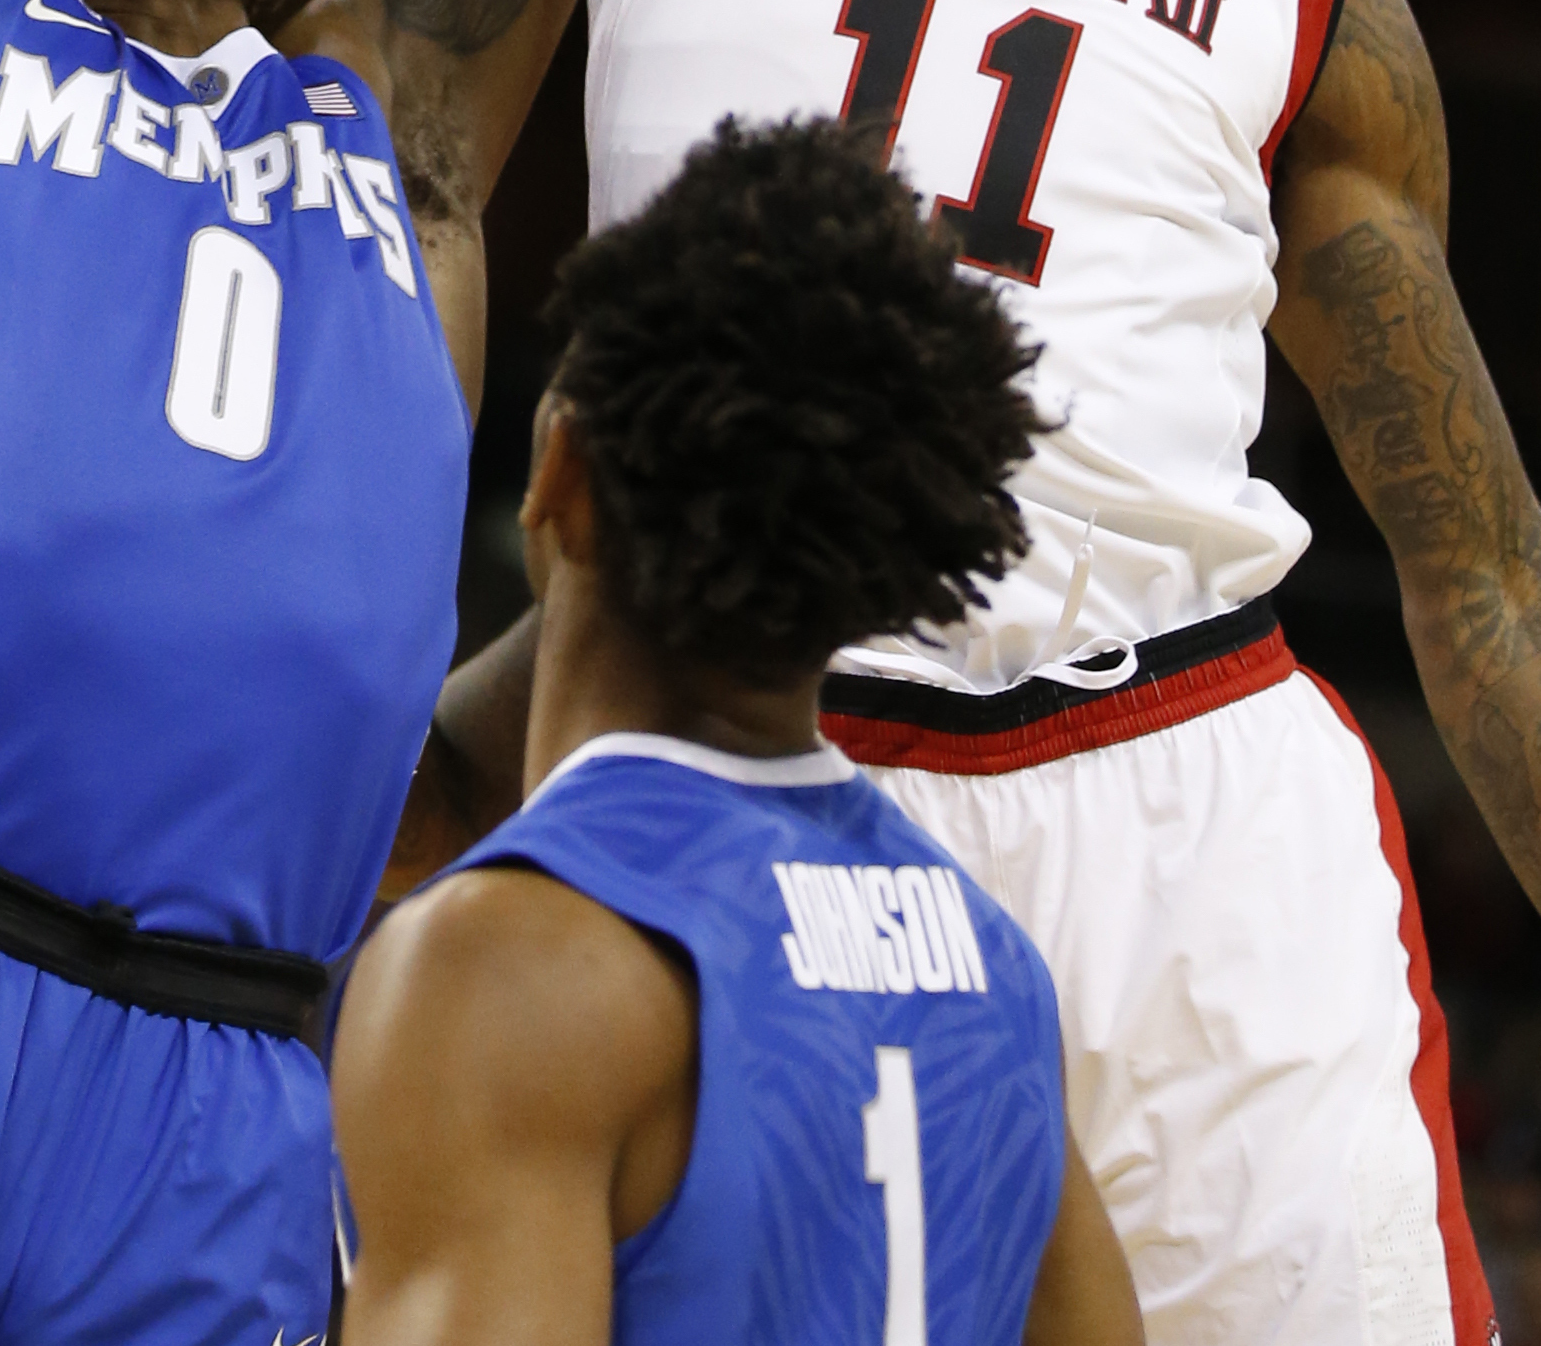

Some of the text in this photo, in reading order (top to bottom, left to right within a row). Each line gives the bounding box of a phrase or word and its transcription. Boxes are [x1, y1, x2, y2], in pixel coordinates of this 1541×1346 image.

[165, 225, 283, 462] 0
[771, 860, 989, 995] JOHNSON
[861, 1044, 927, 1346] 1
